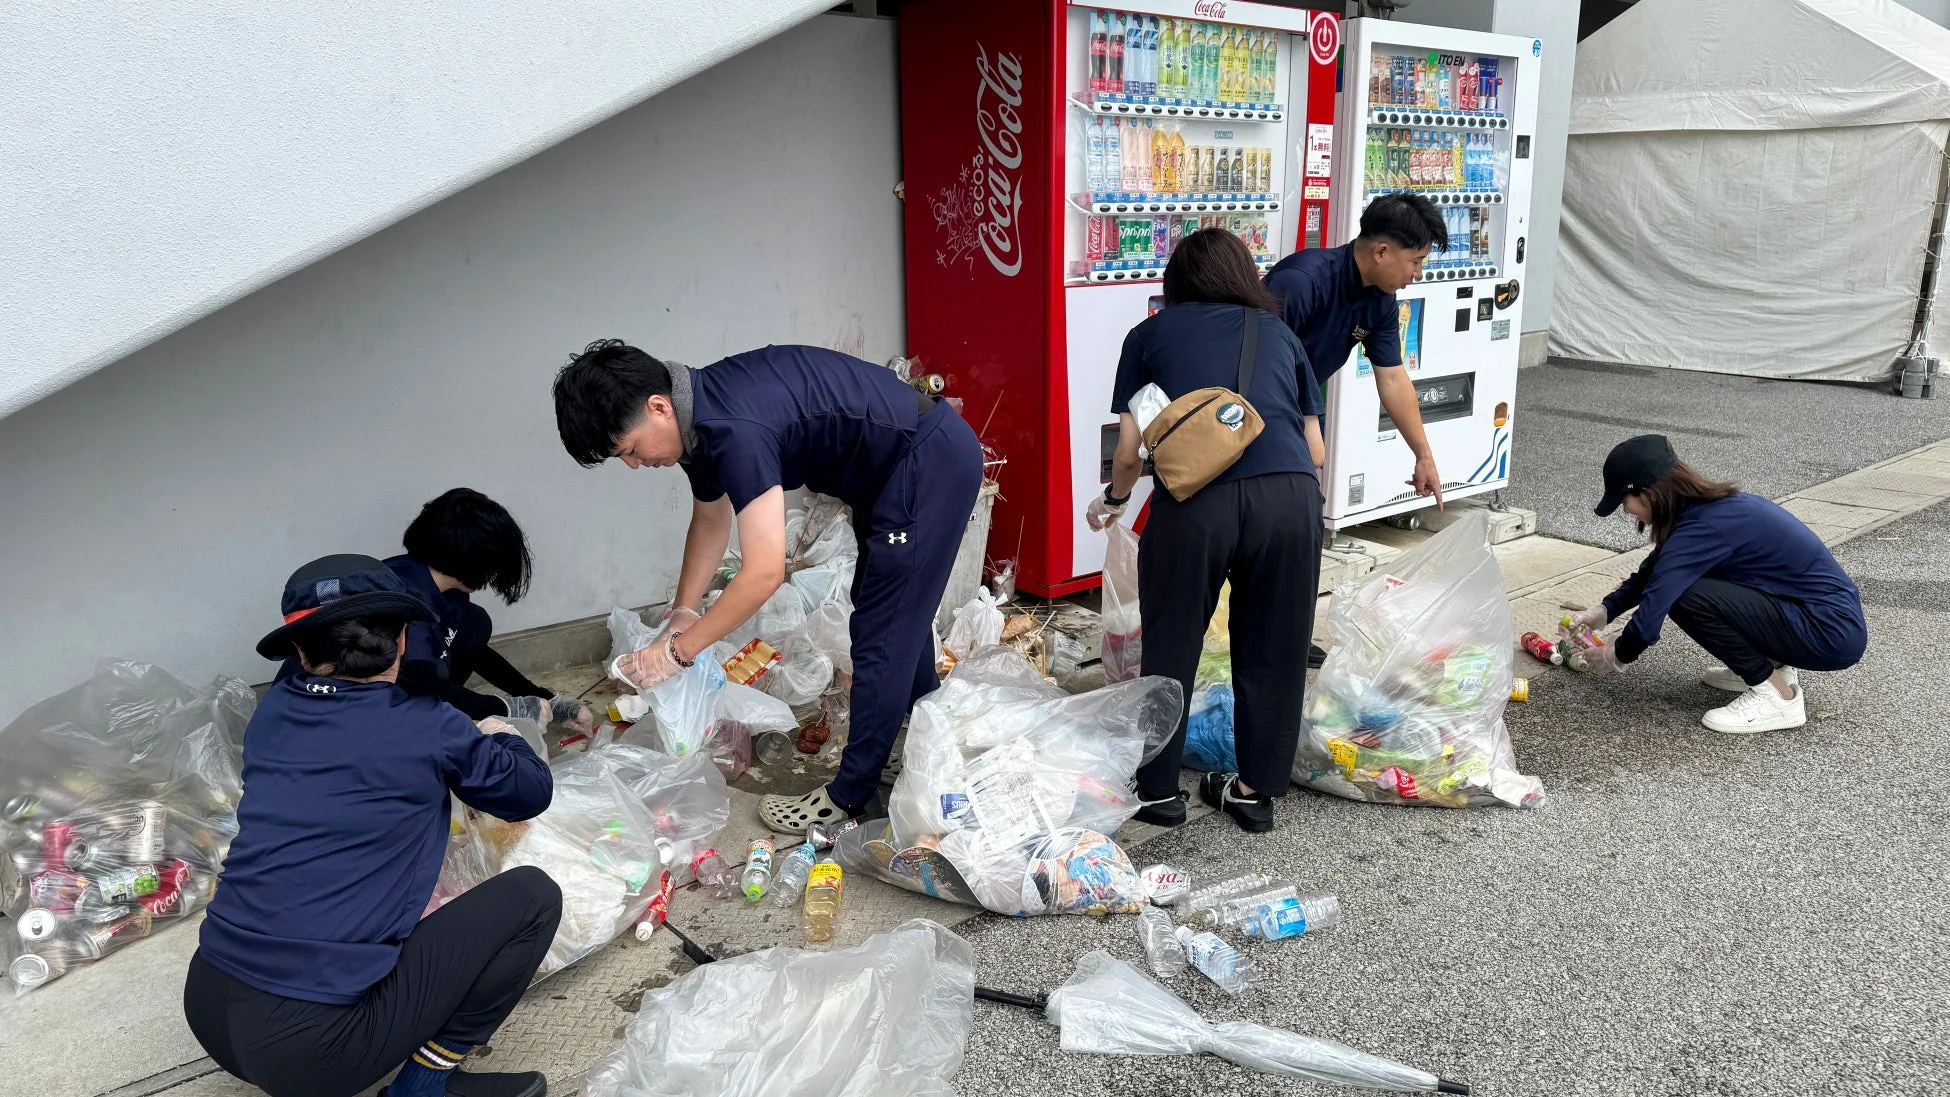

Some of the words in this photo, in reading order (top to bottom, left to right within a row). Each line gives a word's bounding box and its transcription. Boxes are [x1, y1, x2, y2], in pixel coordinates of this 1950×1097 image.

[1194, 0, 1227, 20] Coca-Cola
[1438, 53, 1454, 66] ITO
[1453, 55, 1466, 67] EN
[976, 40, 1023, 277] Coca-Cola
